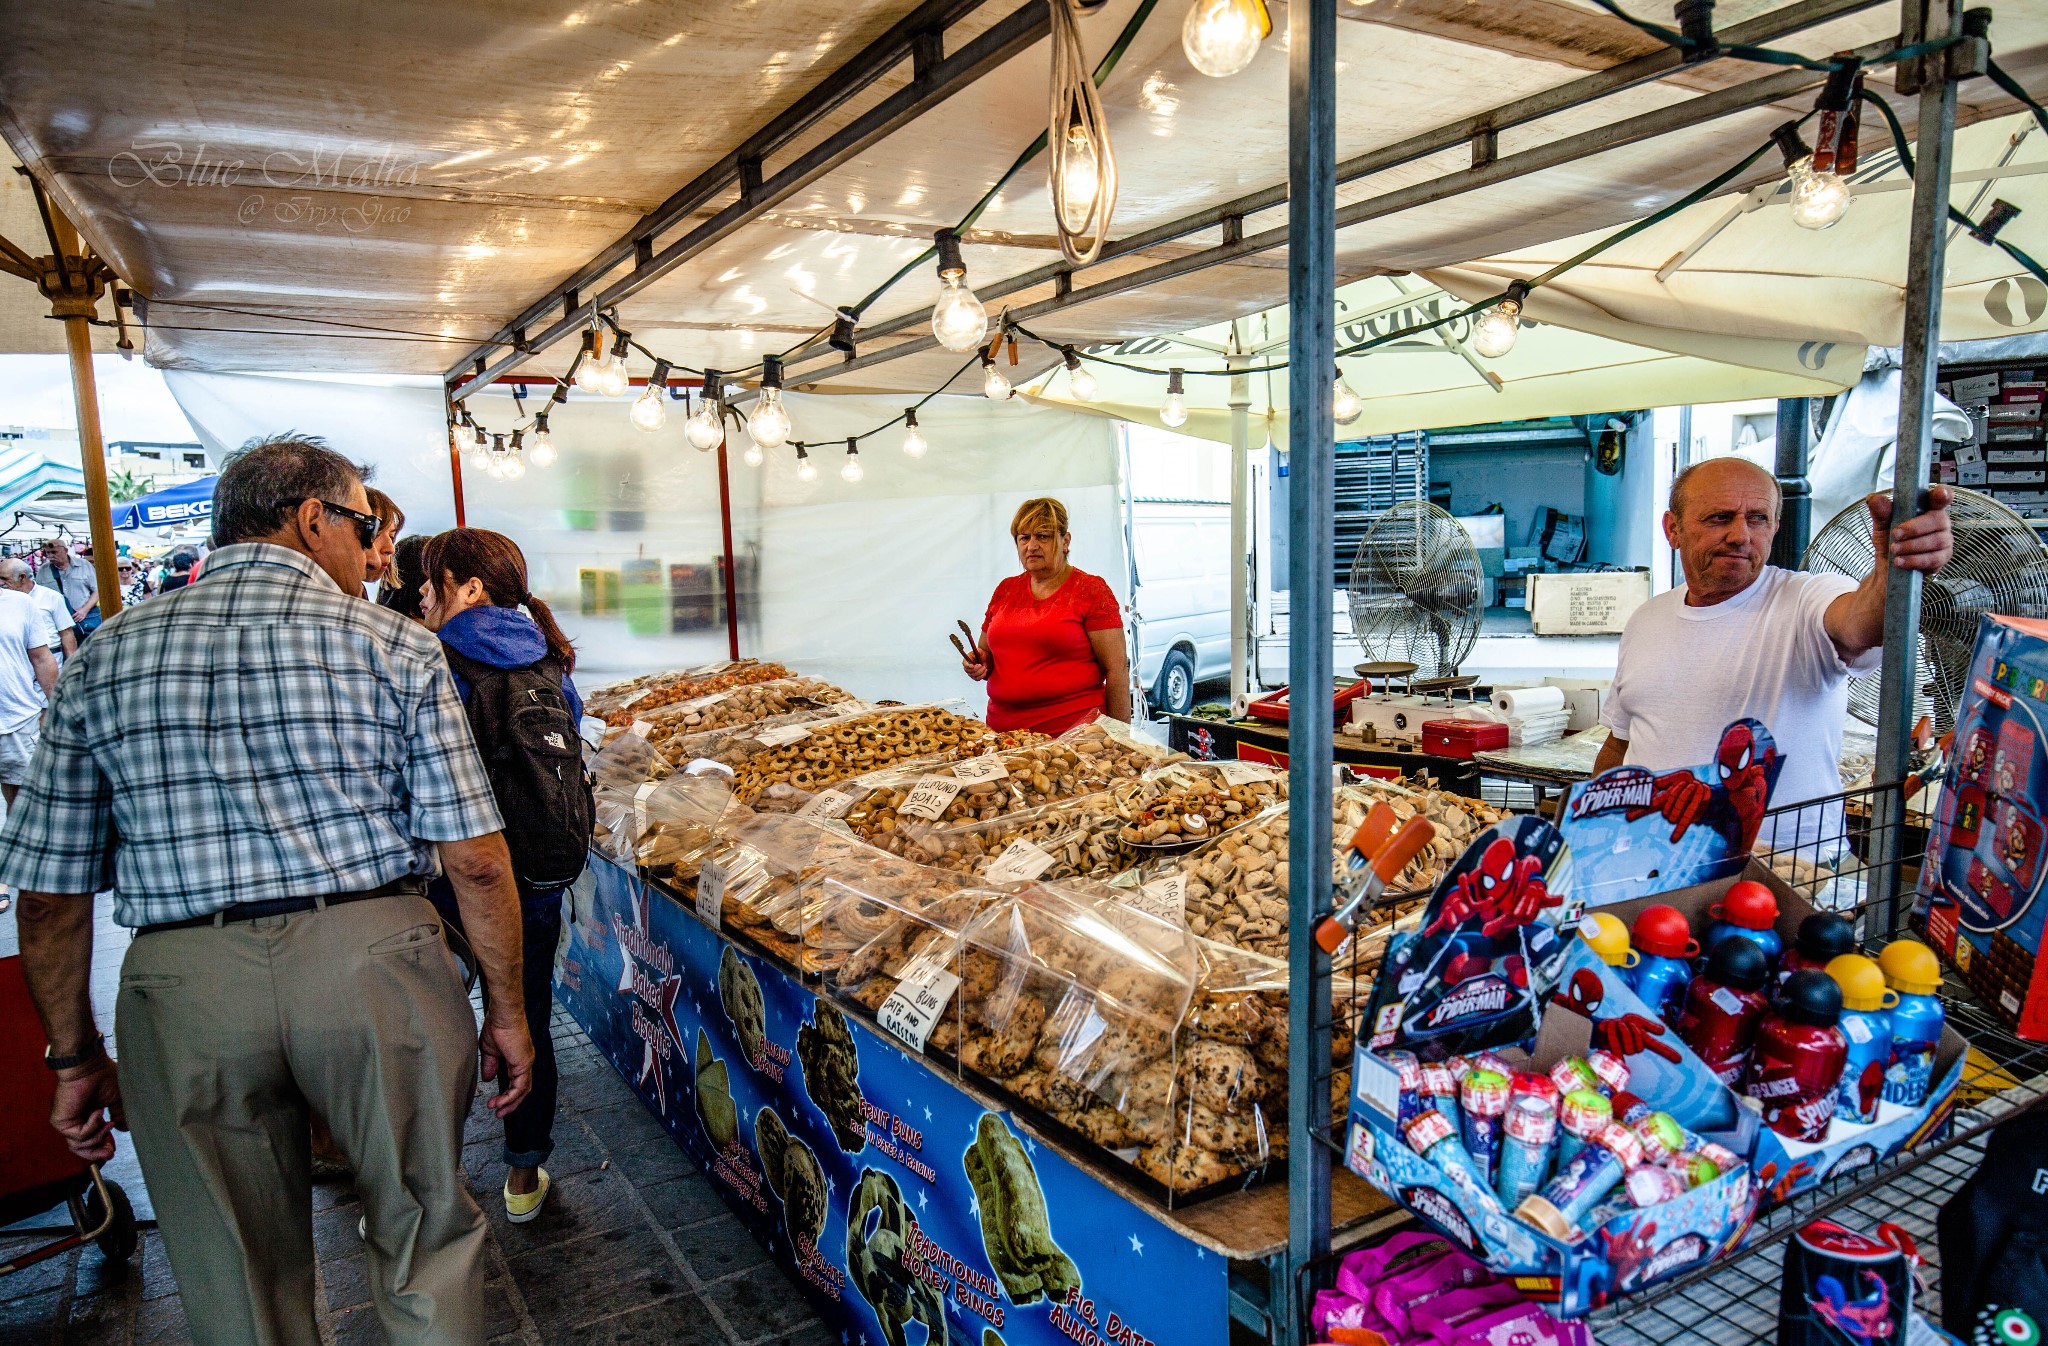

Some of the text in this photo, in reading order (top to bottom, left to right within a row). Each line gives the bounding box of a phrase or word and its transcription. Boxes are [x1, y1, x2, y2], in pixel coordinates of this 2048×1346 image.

[917, 778, 958, 794] ALMOND
[631, 961, 665, 1013] Baked
[915, 989, 939, 1010] BUNS
[631, 1000, 672, 1061] Biscuits
[883, 997, 919, 1028] DATE AND
[886, 1014, 919, 1048] RAISINS
[858, 1096, 923, 1150] FRUIT BUNS
[875, 1133, 898, 1159] DATES
[905, 1152, 936, 1183] RAISINS
[906, 1219, 1000, 1300] TRADITIONAL
[901, 1246, 1005, 1328] HONEY RINGS
[1066, 1285, 1099, 1328] FIG,
